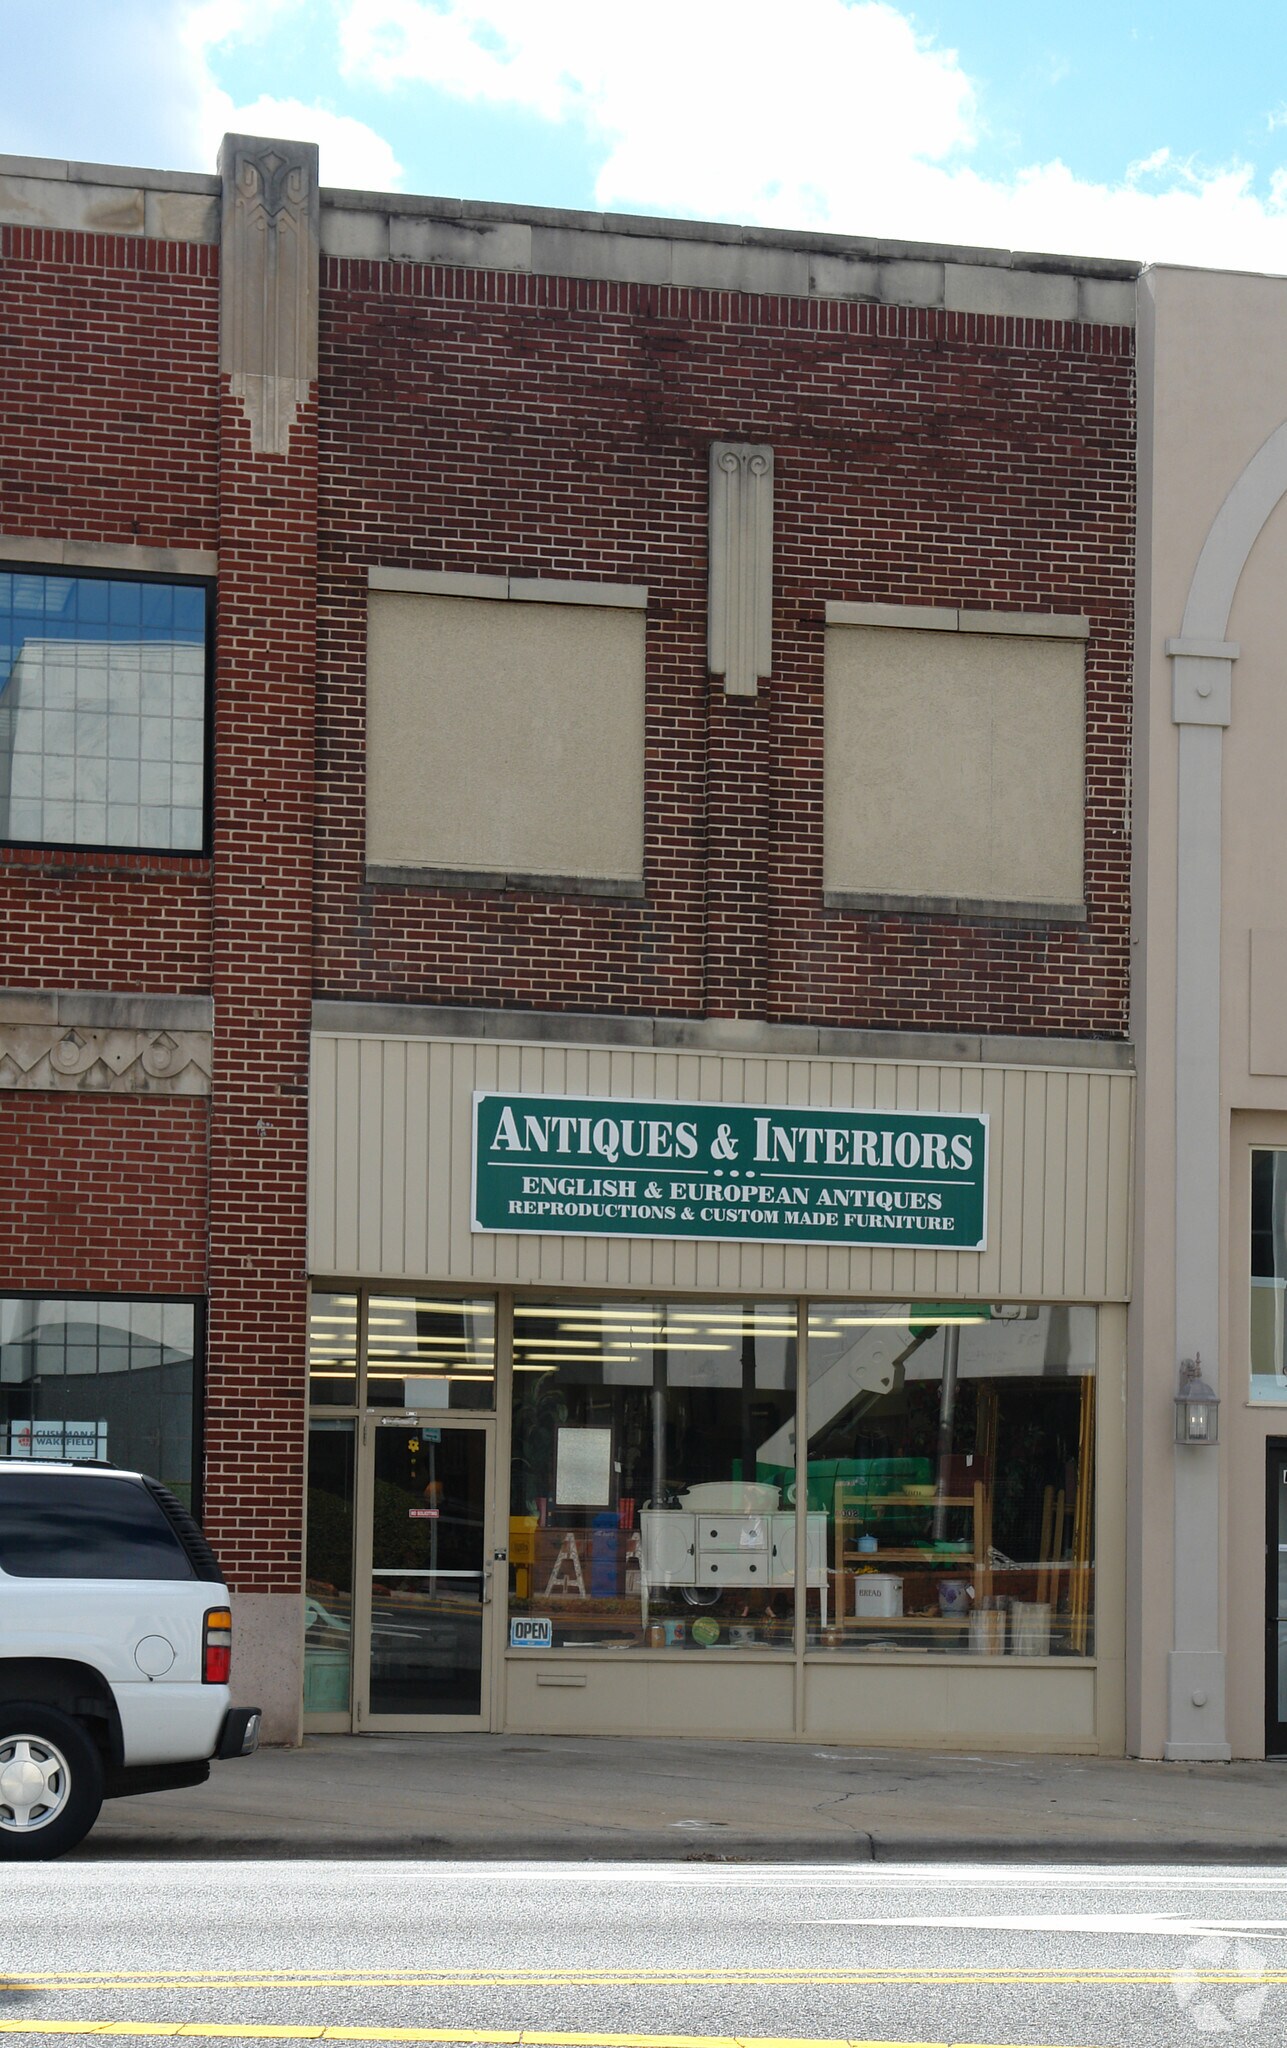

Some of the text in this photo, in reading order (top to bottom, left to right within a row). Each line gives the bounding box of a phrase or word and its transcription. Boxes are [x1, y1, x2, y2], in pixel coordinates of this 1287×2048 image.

[489, 1105, 973, 1171] ANTIQUES & INTERIORS
[522, 1176, 942, 1212] ENGLISH & EUROPEAN ANTIQUES
[508, 1200, 955, 1231] REPRODUCTIONS & CUSTOM MADE FURNITURE
[859, 1589, 882, 1597] BREAD
[515, 1622, 548, 1639] OPEN
